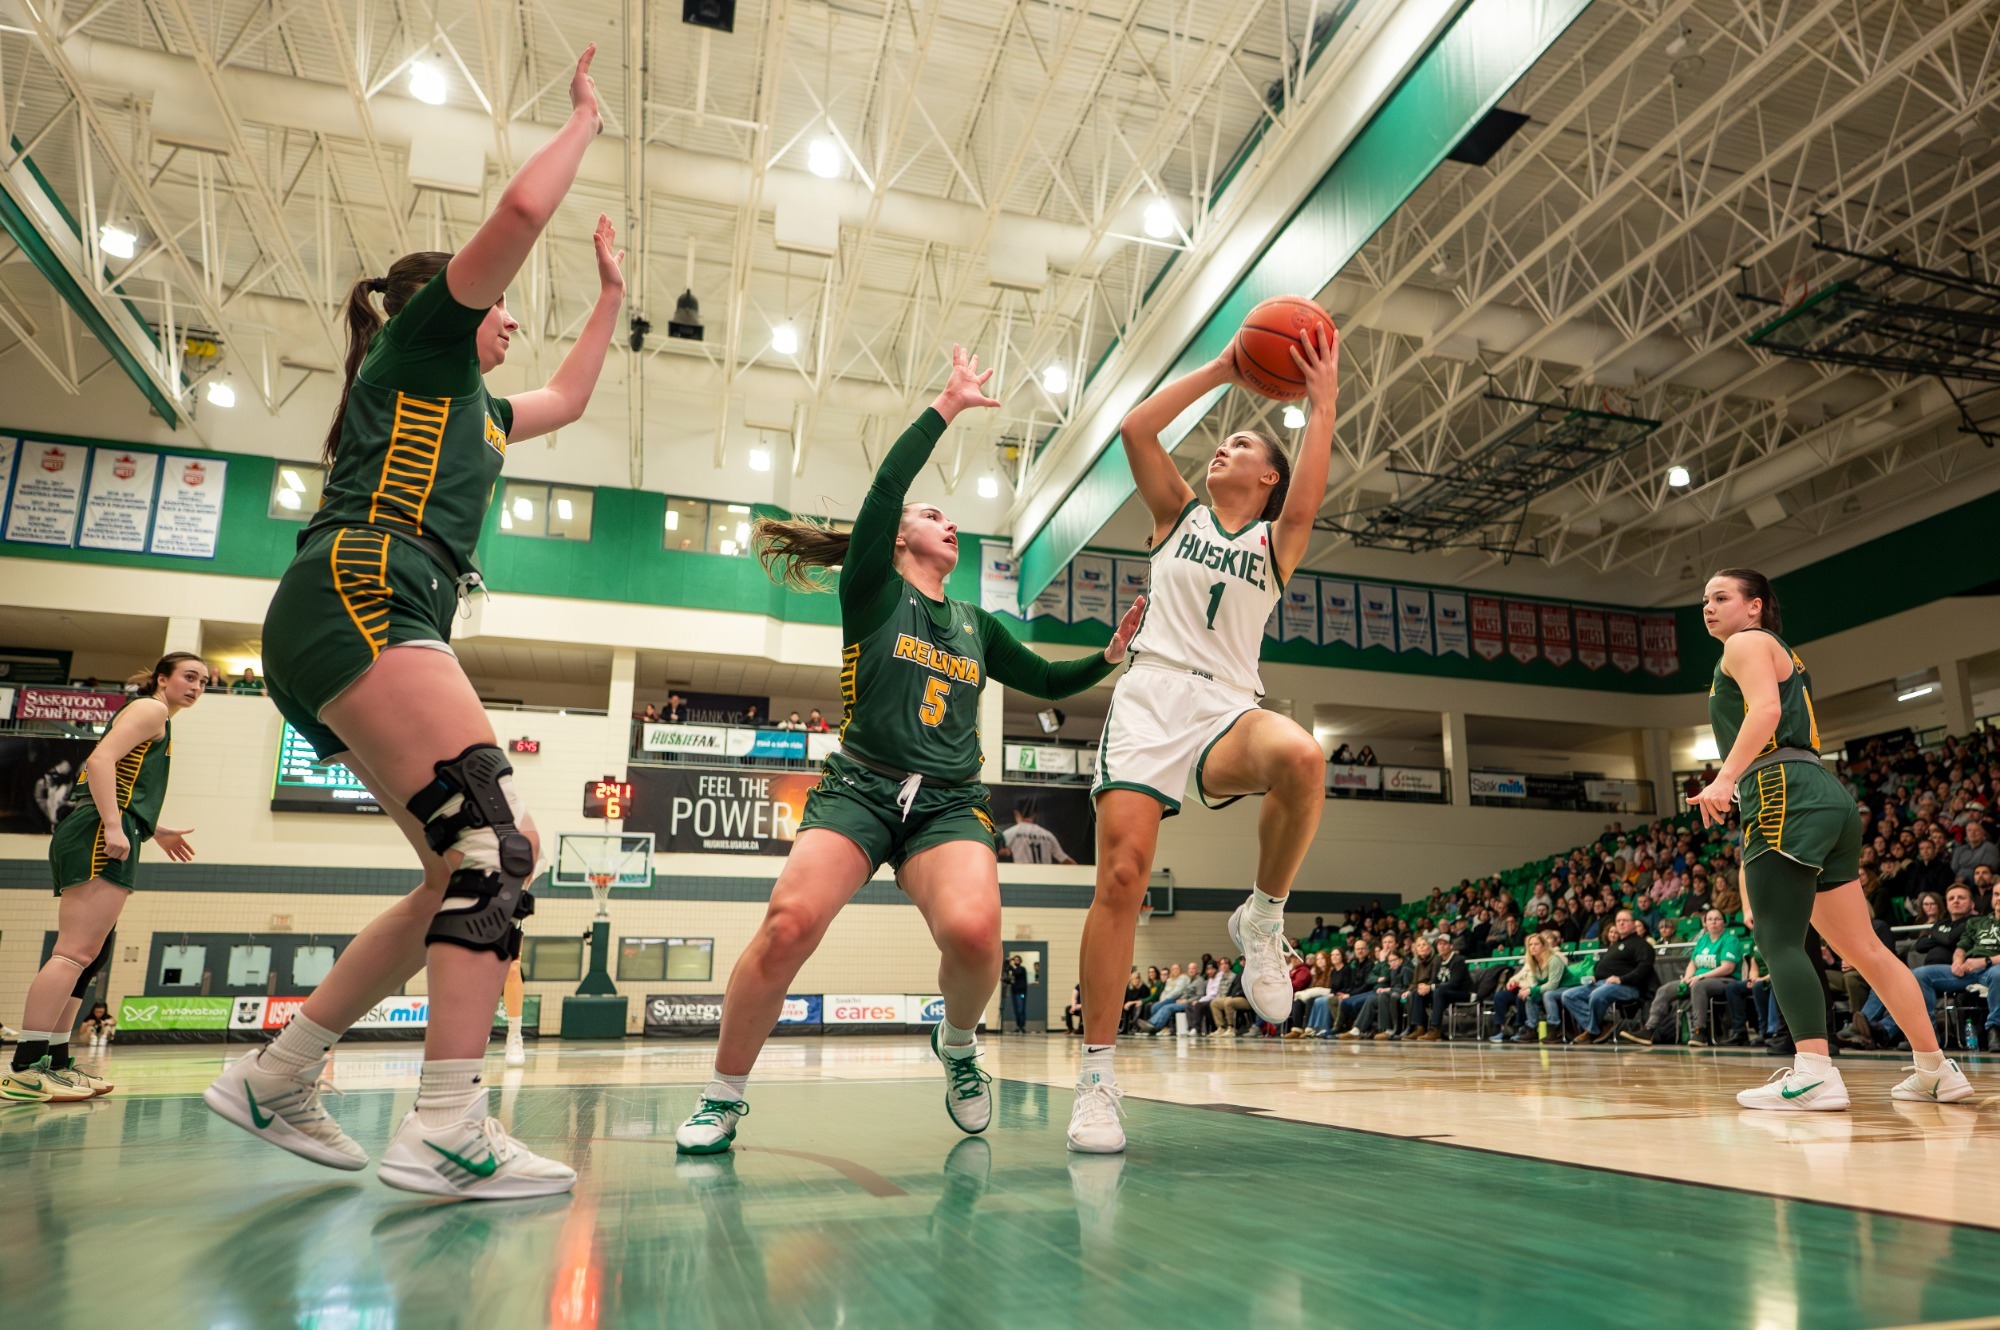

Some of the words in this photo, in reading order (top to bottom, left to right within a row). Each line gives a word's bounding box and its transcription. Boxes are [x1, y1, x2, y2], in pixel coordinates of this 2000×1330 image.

[1206, 581, 1227, 631] 1
[1645, 635, 1673, 651] WEST
[25, 690, 106, 709] SASKATOON
[918, 675, 952, 728] 5
[698, 775, 735, 797] FEEL
[739, 777, 770, 799] THE
[1472, 777, 1497, 791] Sask
[1497, 780, 1525, 794] milk
[606, 797, 620, 818] 6
[671, 797, 793, 839] POWER
[161, 1008, 228, 1016] innovation
[653, 999, 723, 1021] Synergy
[835, 1005, 896, 1020] cares
